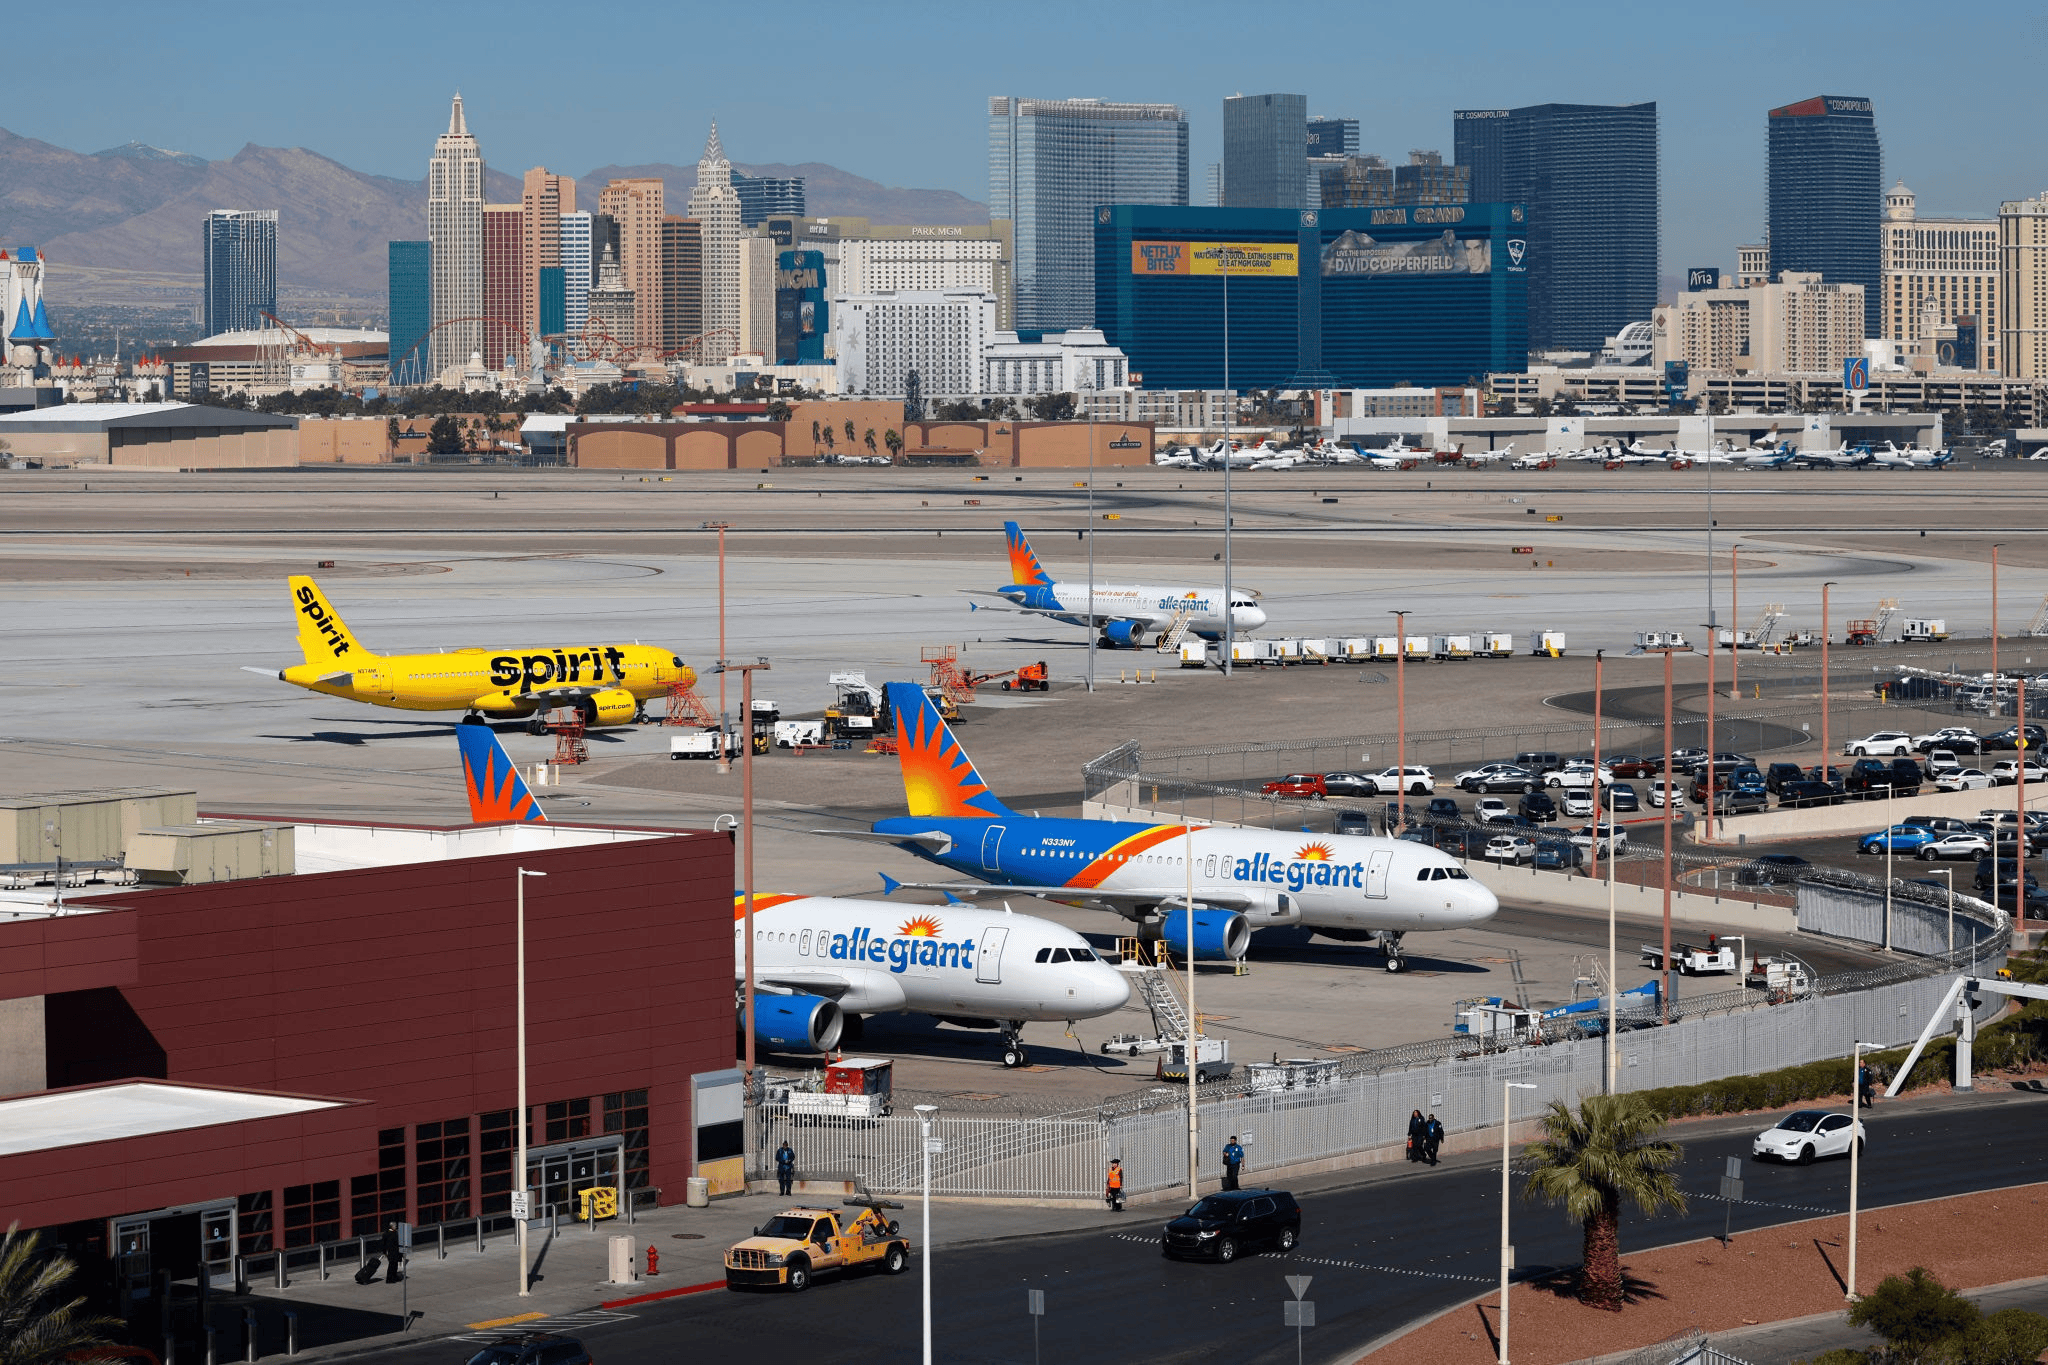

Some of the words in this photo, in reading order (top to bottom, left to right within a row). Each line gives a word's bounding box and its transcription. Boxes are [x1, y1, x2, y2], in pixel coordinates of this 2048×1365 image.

[1466, 110, 1510, 119] COSMOPOLITAN
[1306, 129, 1320, 145] dara
[1370, 209, 1407, 225] MGM
[1413, 206, 1465, 223] GRAND
[912, 227, 936, 236] PARK
[938, 227, 962, 236] MGM
[1140, 245, 1182, 259] NETFLIX
[1248, 252, 1267, 260] EATING
[1147, 258, 1176, 271] BITES
[1252, 260, 1272, 268] GRAND
[775, 268, 819, 290] MGM
[1690, 270, 1713, 287] Aria
[1849, 358, 1866, 390] 6
[1159, 596, 1210, 613] allegiant
[296, 586, 350, 658] spirit
[490, 646, 625, 695] spirit
[598, 703, 632, 711] spirit.com
[1041, 837, 1077, 847] N333NV
[1233, 852, 1364, 893] allegiant
[829, 926, 975, 974] allegiant
